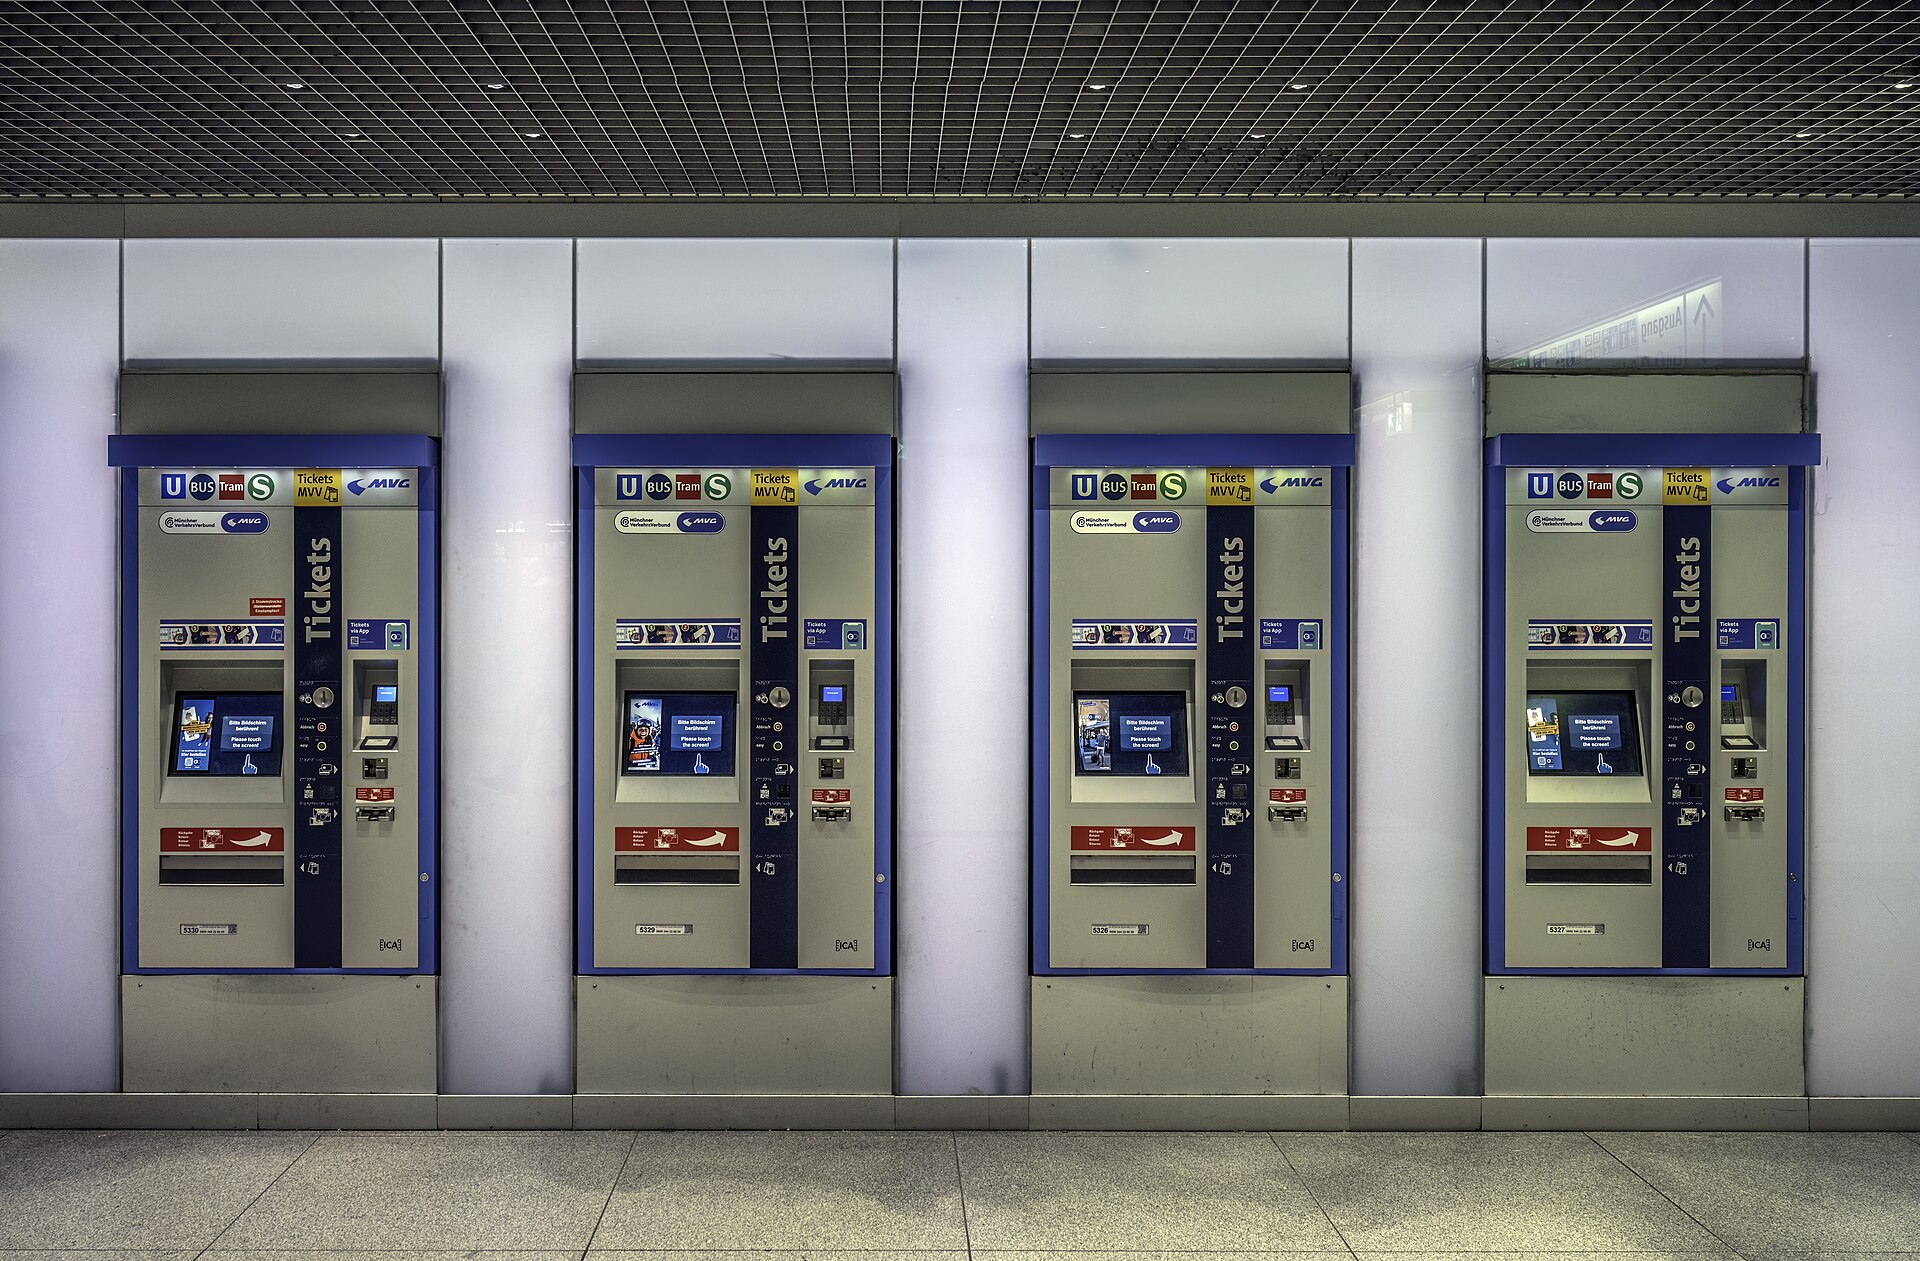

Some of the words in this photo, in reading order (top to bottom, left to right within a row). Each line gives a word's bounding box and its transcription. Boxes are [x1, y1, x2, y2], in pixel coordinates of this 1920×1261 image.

[298, 474, 333, 484] Tickets
[368, 478, 410, 488] MVG
[754, 474, 790, 484] Tickets
[825, 478, 867, 488] MVG
[1210, 472, 1246, 483] Tickets
[1281, 477, 1323, 487] MVG
[1667, 472, 1702, 483] Tickets
[1738, 477, 1780, 487] MVG
[166, 477, 180, 496] U
[190, 480, 214, 493] BUS
[220, 482, 244, 492] Tram
[252, 476, 270, 498] S
[298, 486, 322, 497] MVV
[622, 478, 636, 496] U
[647, 480, 671, 493] BUS
[676, 482, 700, 492] Tram
[709, 476, 727, 498] S
[754, 486, 780, 497] MVV
[1078, 478, 1092, 496] U
[1102, 480, 1126, 493] BUS
[1132, 481, 1156, 491] Tram
[1164, 476, 1183, 498] S
[1210, 486, 1235, 496] MVV
[1534, 476, 1548, 495] U
[1559, 479, 1582, 492] BUS
[1588, 480, 1612, 490] Tram
[1620, 475, 1639, 497] S
[1666, 485, 1692, 496] MVV
[304, 537, 332, 644] Tickets
[760, 537, 788, 643] Tickets
[1216, 536, 1244, 643] Tickets
[1672, 536, 1700, 643] Tickets
